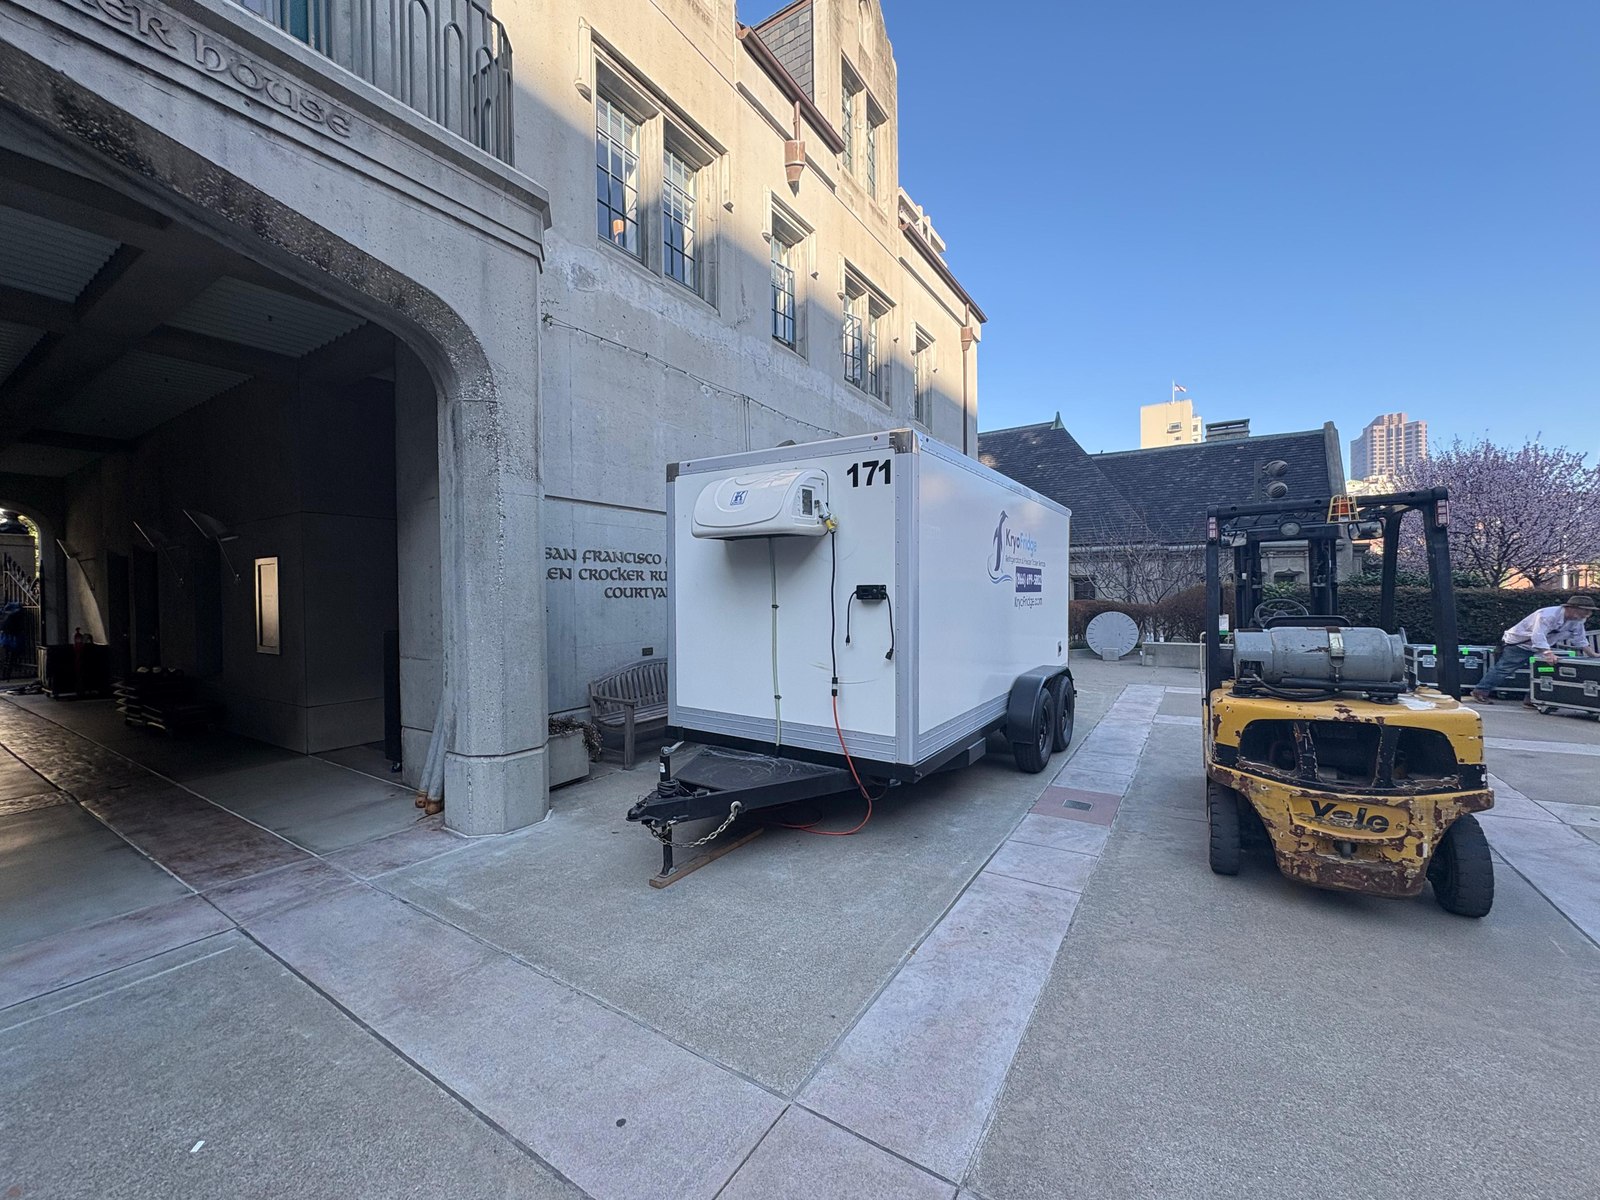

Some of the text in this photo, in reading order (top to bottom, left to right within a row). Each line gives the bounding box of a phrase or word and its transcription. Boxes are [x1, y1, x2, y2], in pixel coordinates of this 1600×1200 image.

[846, 459, 892, 488] 171
[545, 547, 577, 561] SAN
[582, 550, 662, 565] FRANCISCO
[546, 567, 572, 580] EN
[578, 567, 645, 581] CROCKER
[604, 587, 668, 600] COURTYA
[1310, 800, 1390, 833] Yale
